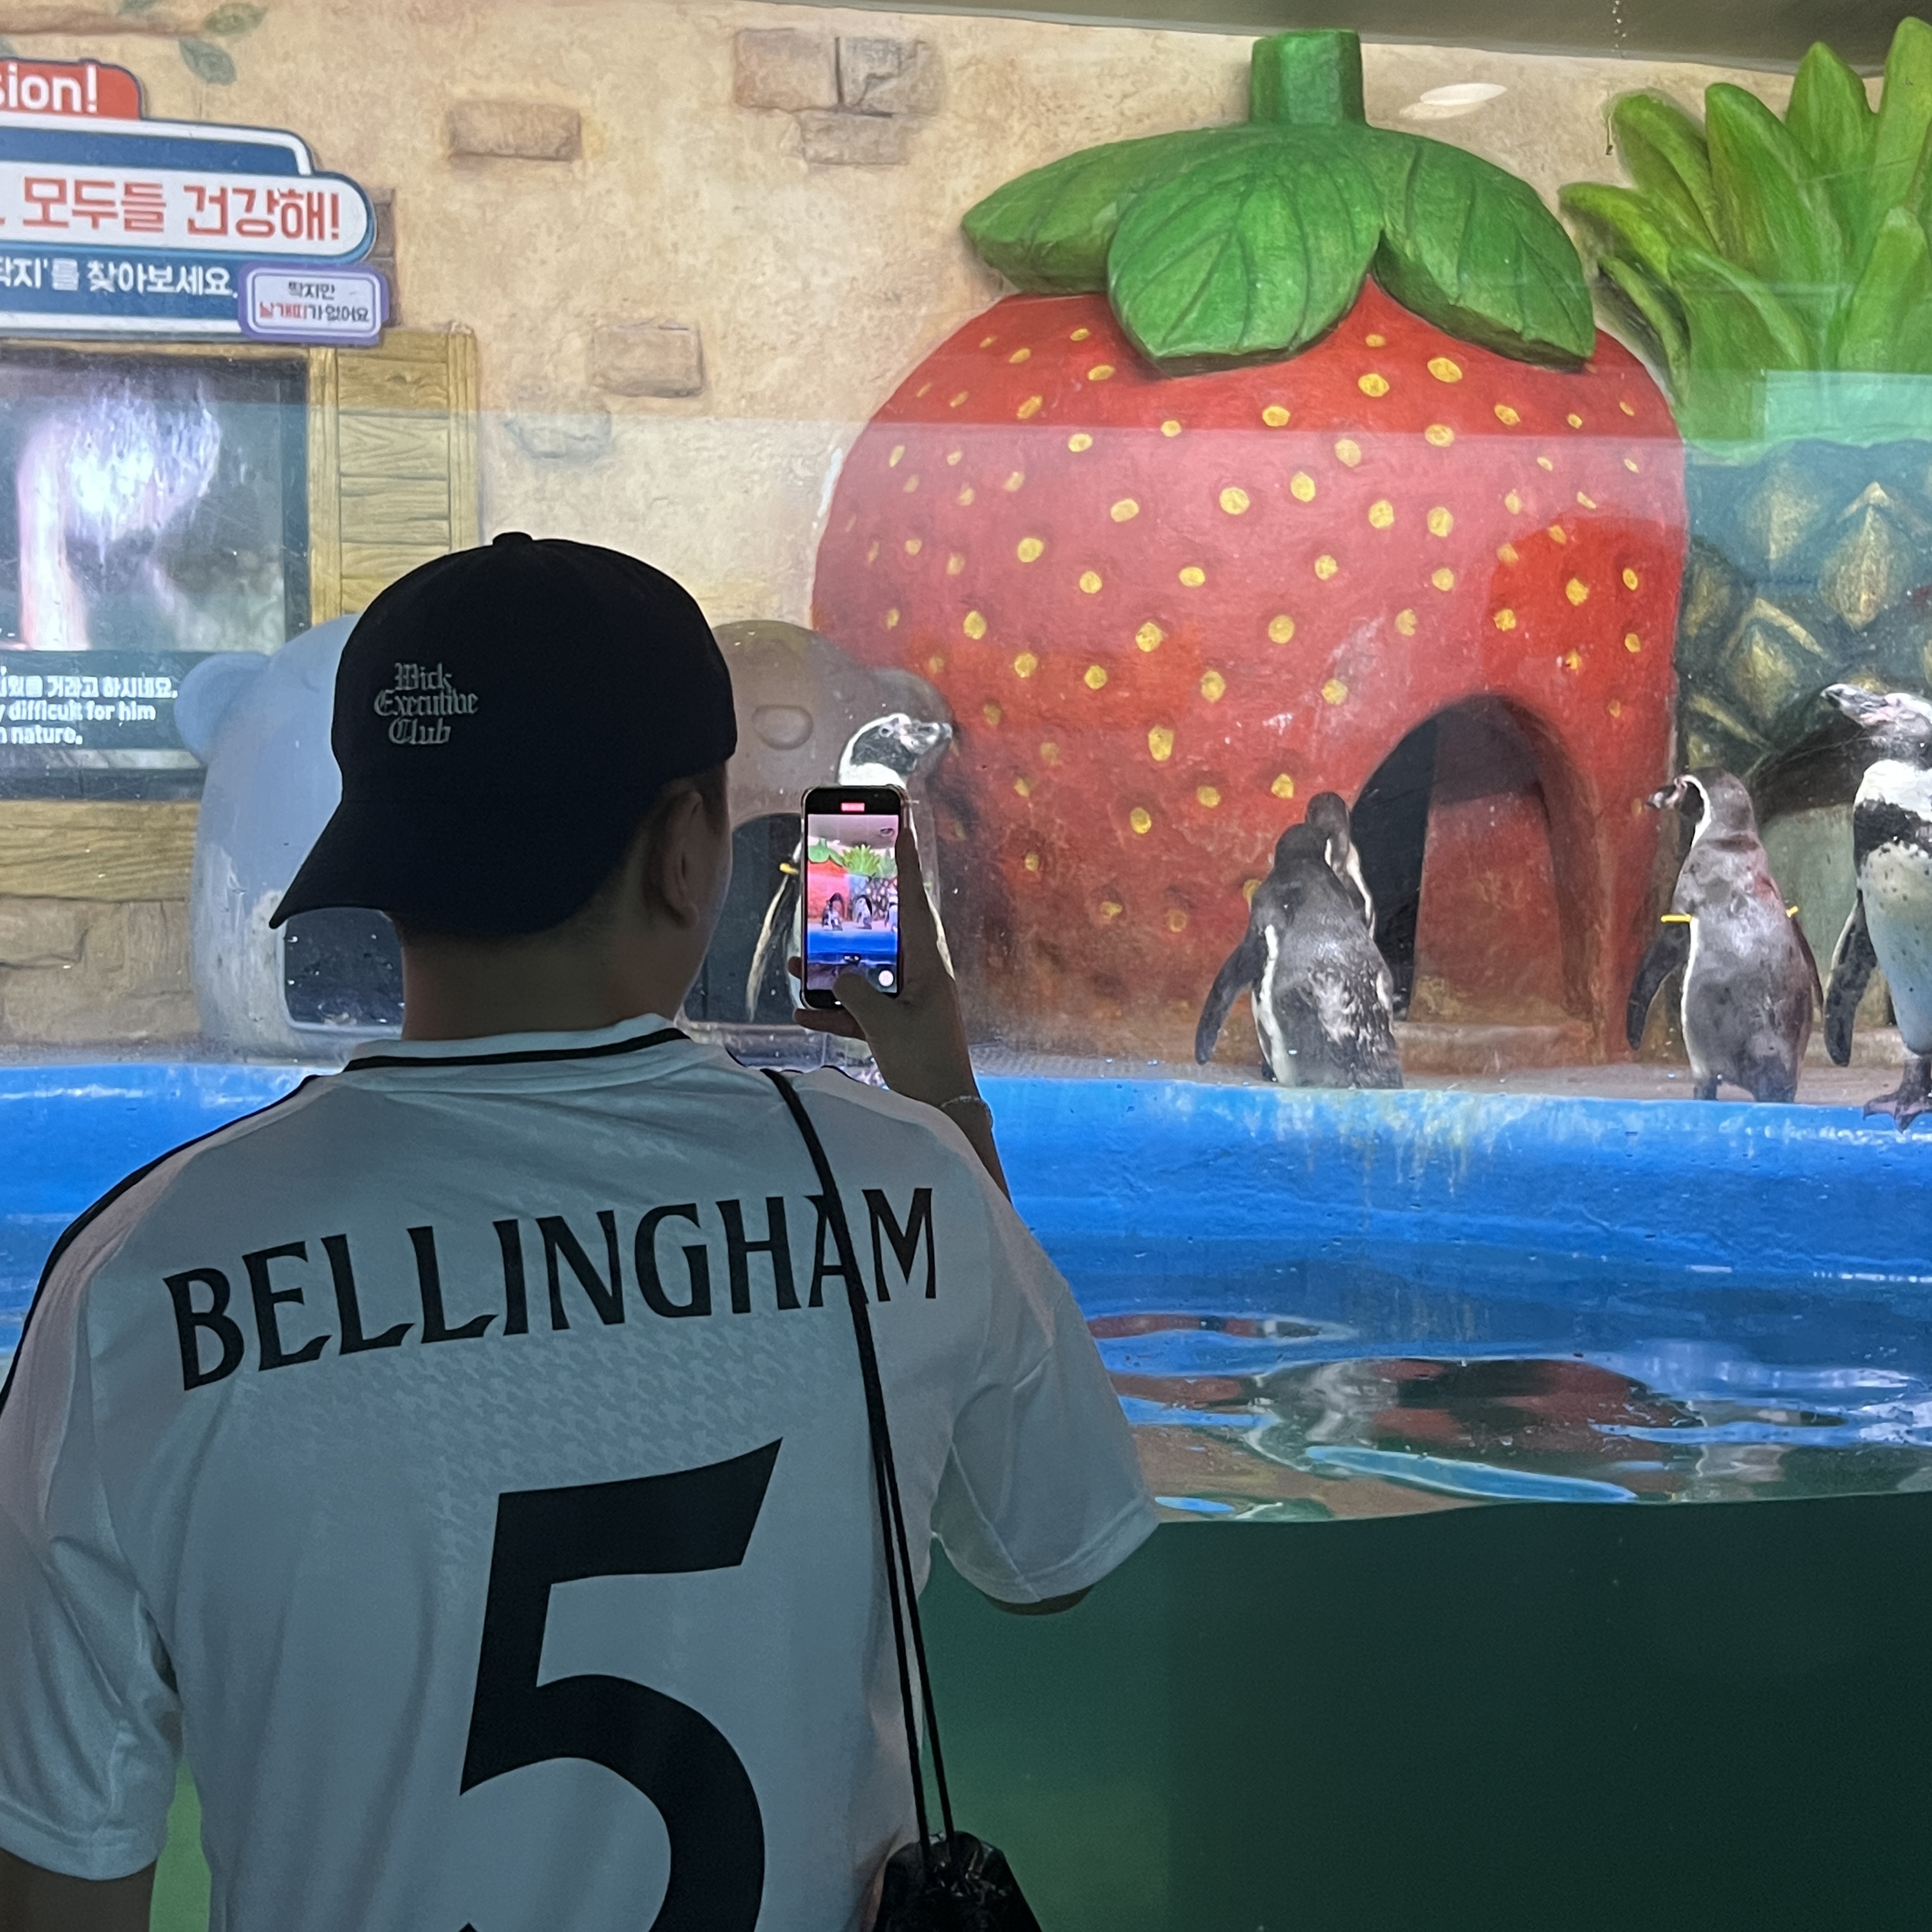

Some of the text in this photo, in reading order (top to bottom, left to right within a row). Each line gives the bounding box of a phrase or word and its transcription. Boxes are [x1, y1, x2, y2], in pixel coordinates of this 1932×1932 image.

[0, 63, 97, 114] ion!
[22, 176, 340, 241] 모두들 건강해!
[87, 259, 238, 299] 찾아보세요.
[288, 281, 335, 300] 딱지만
[47, 675, 99, 698] 거라고
[102, 676, 178, 699] 하시네요.
[394, 663, 452, 691] Wick
[8, 700, 83, 721] difficult
[86, 701, 115, 721] for
[118, 701, 156, 721] him
[374, 688, 479, 716] Executive
[11, 724, 82, 744] nature.
[388, 717, 451, 744] Club
[162, 1187, 937, 1392] BELLINGHAM
[459, 1438, 783, 1932] 5
